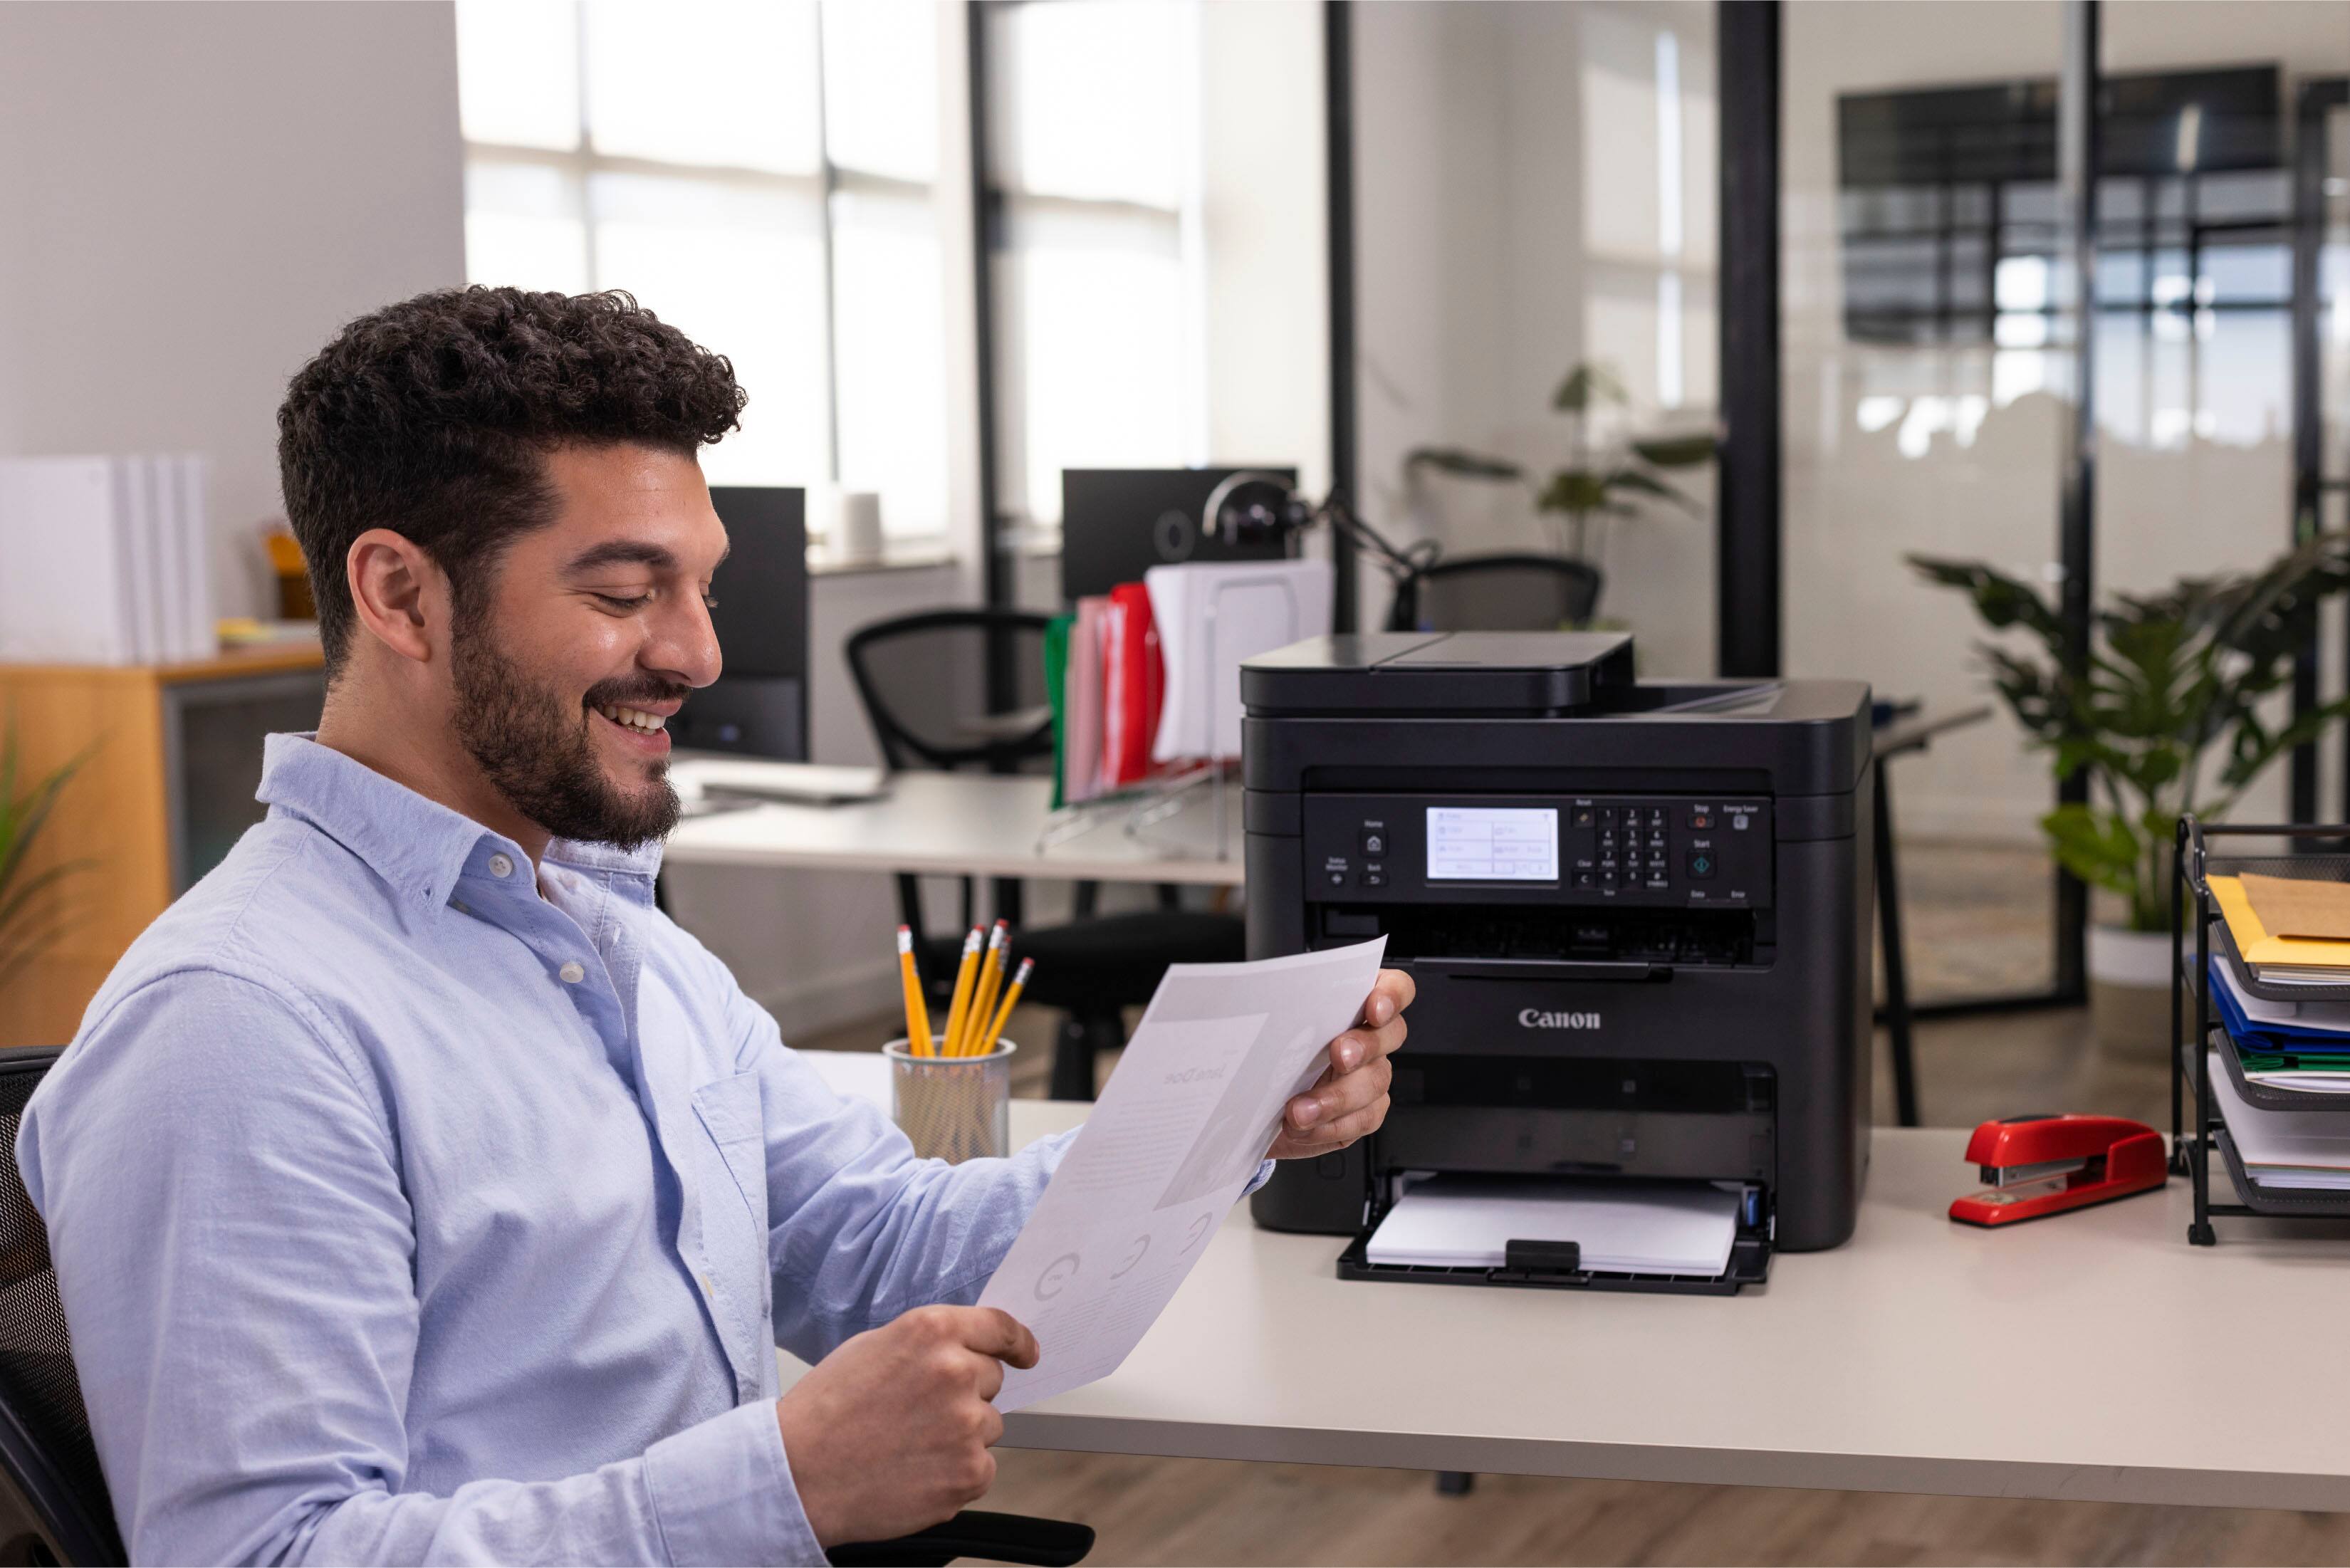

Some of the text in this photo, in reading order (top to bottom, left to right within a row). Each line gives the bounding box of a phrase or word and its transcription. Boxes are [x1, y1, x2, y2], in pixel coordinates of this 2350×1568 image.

[1694, 804, 1710, 814] Stop
[1723, 805, 1743, 814] Energy
[1364, 820, 1384, 828] Home
[1693, 840, 1710, 848] Start
[1580, 874, 1588, 884] C
[1519, 1009, 1600, 1029] Canon
